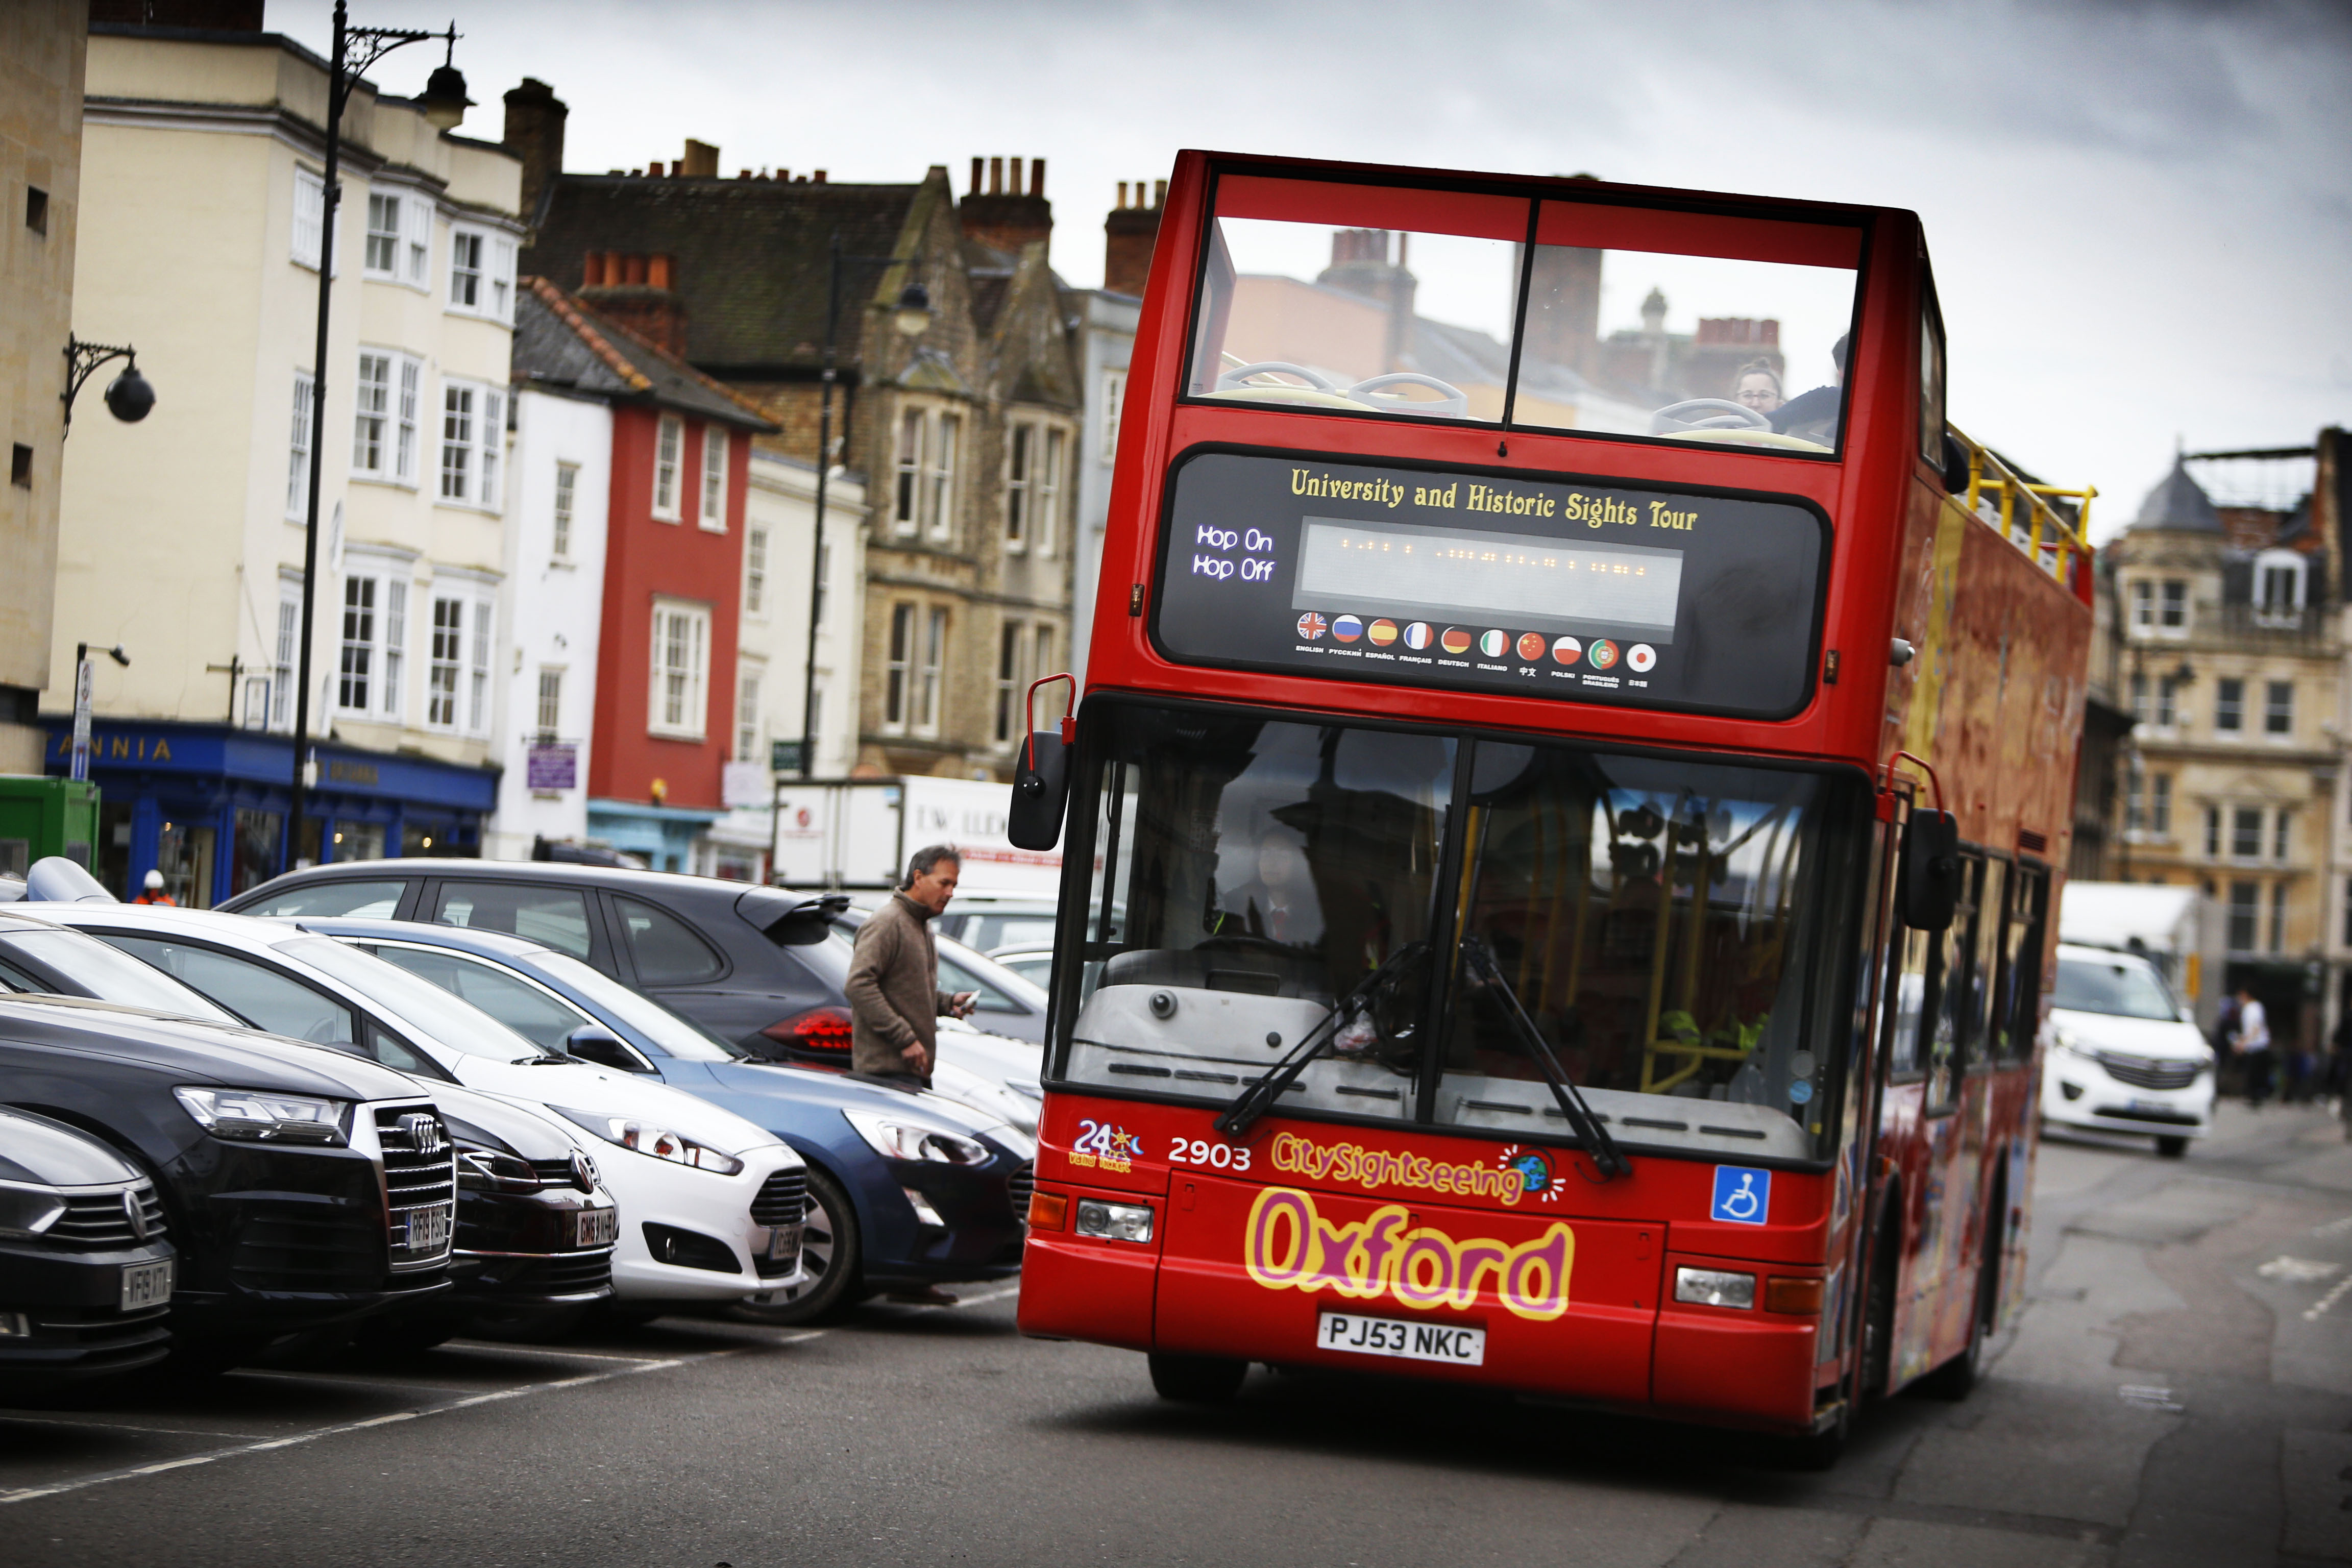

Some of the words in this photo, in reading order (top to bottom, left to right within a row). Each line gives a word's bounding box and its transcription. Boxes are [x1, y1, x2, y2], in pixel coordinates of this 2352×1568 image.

[1291, 468, 1404, 508] University
[1414, 482, 1457, 508] and
[1466, 483, 1555, 518] Historic
[1565, 493, 1637, 529] Sights
[1649, 500, 1698, 530] Tour
[1196, 524, 1239, 551] Hop
[1244, 527, 1273, 552] On
[1192, 554, 1235, 580] Hop
[1240, 557, 1276, 581] Off
[1295, 645, 1324, 653] ENGLISH
[1365, 652, 1395, 660] ESPAÑOL
[1399, 655, 1432, 664] FRANÇAIS
[1437, 659, 1469, 668] DEUTSCH
[1477, 663, 1508, 672] ITALIANO
[1518, 667, 1537, 677] 中文
[1551, 670, 1576, 678] POLSKI
[1582, 674, 1620, 683] PORTUGUÊS
[1582, 679, 1619, 689] BRASILEIRO
[46, 731, 172, 762] ANNIA
[1073, 1119, 1111, 1156] 24
[1168, 1137, 1252, 1171] 2903
[1271, 1132, 1525, 1206] CitySightseeing
[1244, 1186, 1575, 1321] Oxford
[1330, 1316, 1407, 1351] PJ53
[1414, 1326, 1473, 1359] NKC
